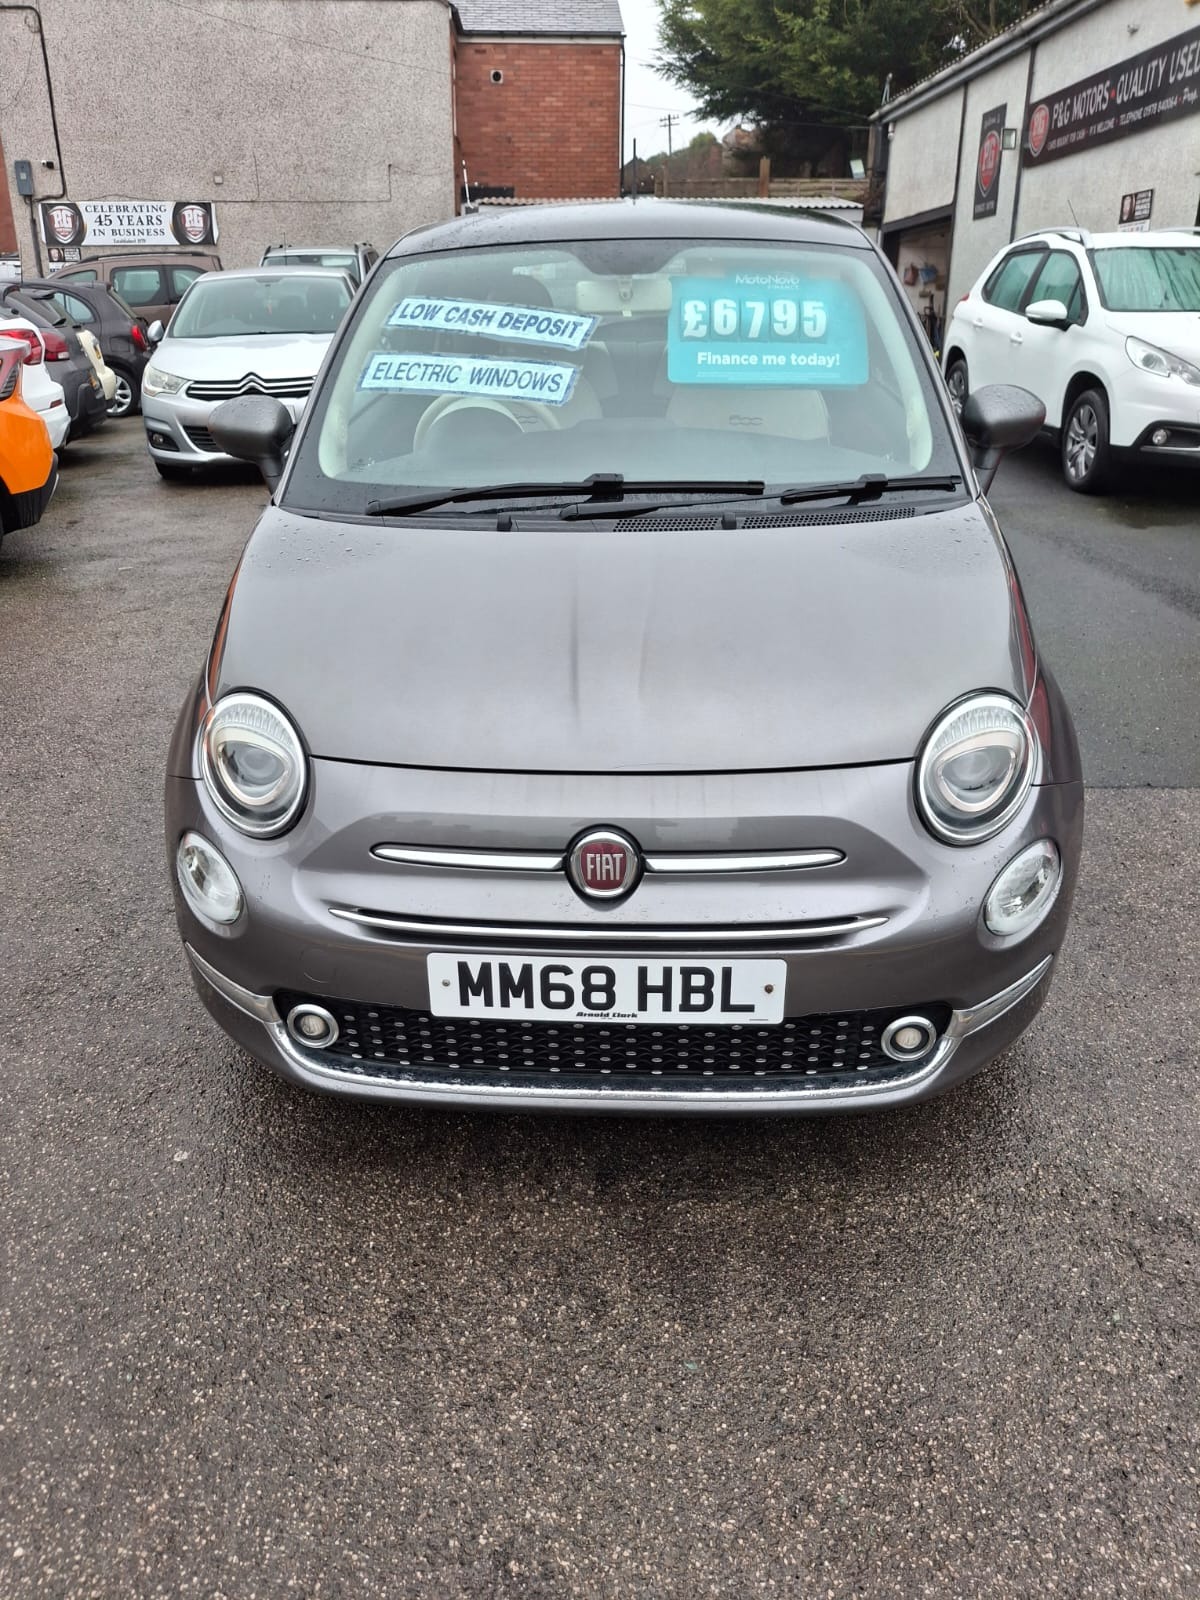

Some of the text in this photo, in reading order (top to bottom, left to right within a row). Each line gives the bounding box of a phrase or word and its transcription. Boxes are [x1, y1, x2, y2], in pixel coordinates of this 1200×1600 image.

[1051, 97, 1070, 128] P&G
[1071, 80, 1110, 122] MOTORS
[1116, 55, 1167, 104] QUALITY
[84, 204, 167, 213] CELEBRATING
[94, 214, 163, 226] 45 YEARS
[92, 228, 166, 237] IN BUSINESS
[735, 274, 800, 285] MotoNovo
[399, 303, 583, 339] LOW CASH DEPOSIT
[683, 299, 827, 338] £6795
[697, 352, 840, 367] Finance me today!
[372, 362, 563, 393] ELECTRIC WINDOWS
[586, 853, 624, 880] FIAT
[457, 961, 755, 1013] MM68 HBL
